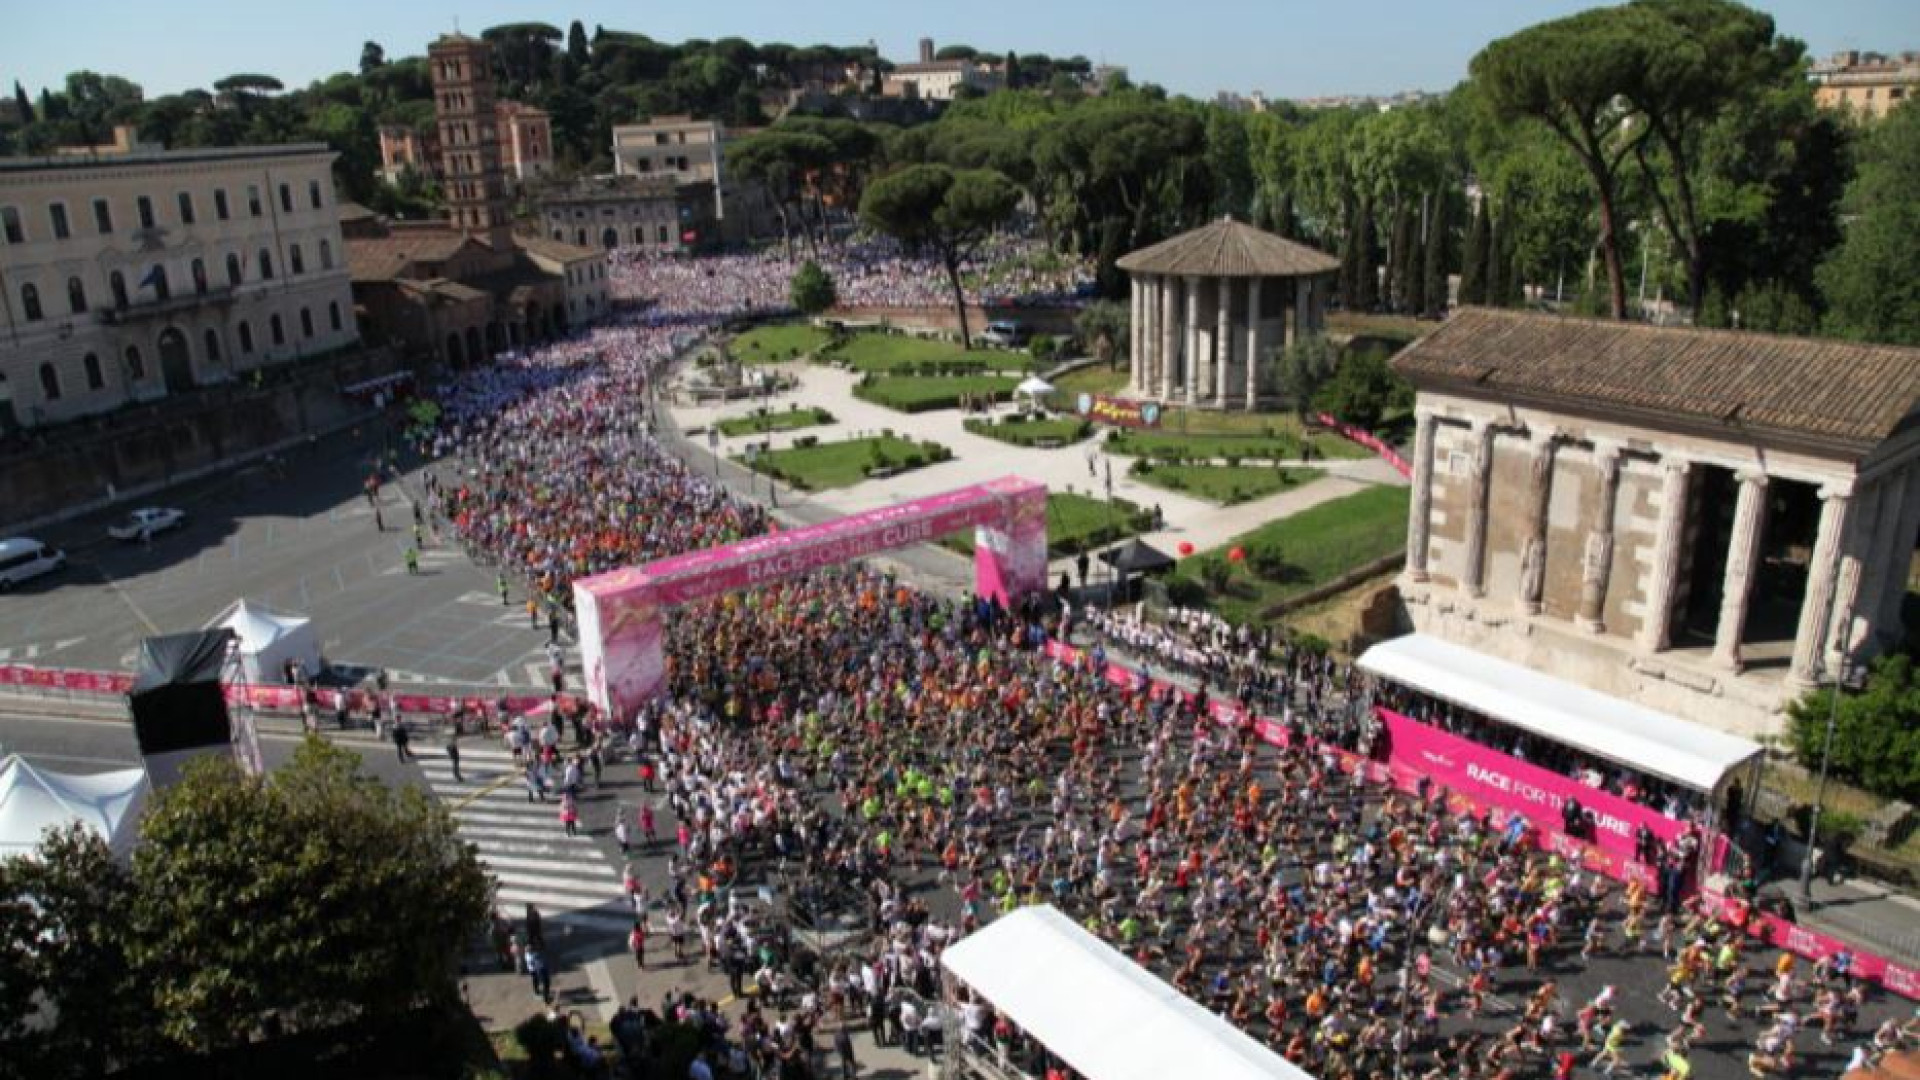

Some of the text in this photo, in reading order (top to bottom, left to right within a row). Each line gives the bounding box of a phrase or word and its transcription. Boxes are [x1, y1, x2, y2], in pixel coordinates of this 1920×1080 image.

[747, 552, 804, 580] RACE
[882, 519, 933, 546] CURE
[1466, 763, 1511, 791] RACE
[1514, 780, 1546, 804] FOR
